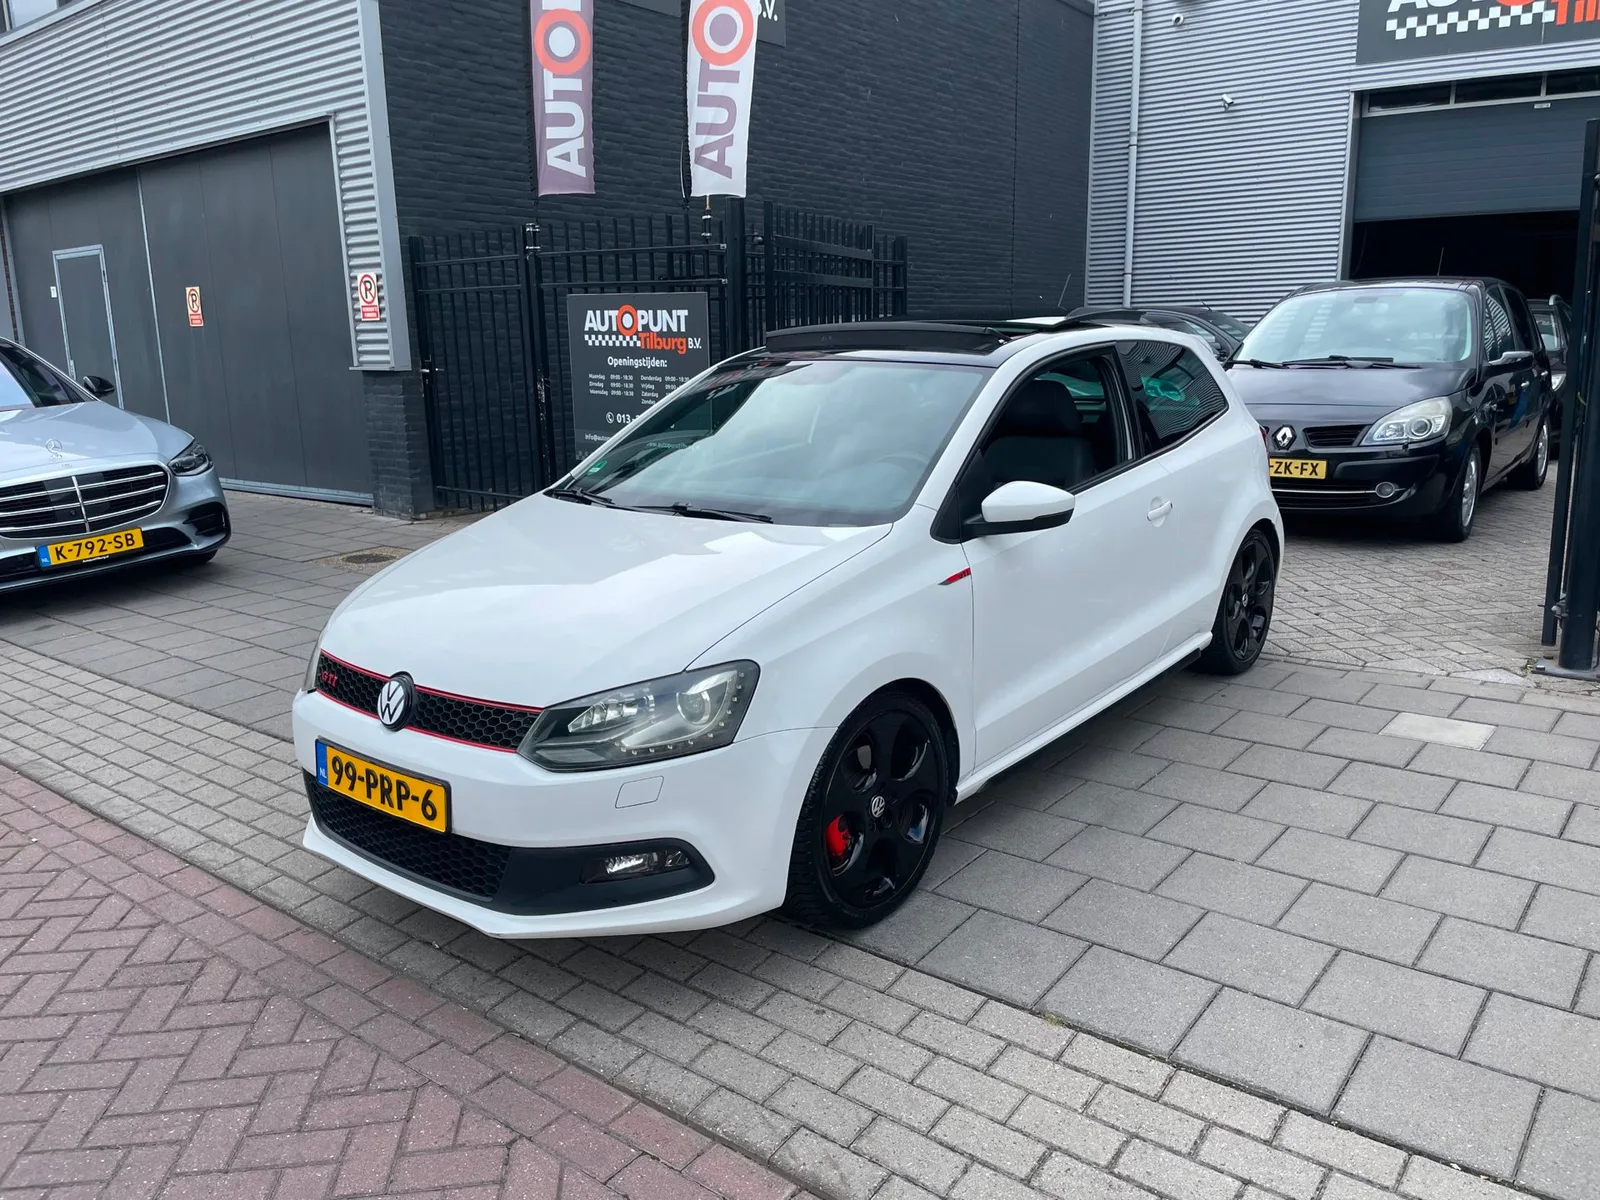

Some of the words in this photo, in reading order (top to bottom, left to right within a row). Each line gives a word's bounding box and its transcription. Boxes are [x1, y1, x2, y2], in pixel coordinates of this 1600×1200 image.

[534, 0, 591, 177] AUTO
[584, 304, 689, 336] AUTOPUNT
[638, 332, 687, 354] Tilburg
[688, 338, 702, 349] B.V.
[607, 356, 668, 368] Openingstijden:
[55, 533, 135, 561] K-792-SB
[321, 671, 338, 688] GTI
[319, 767, 328, 779] NL
[331, 755, 438, 821] 99-PRP-6
